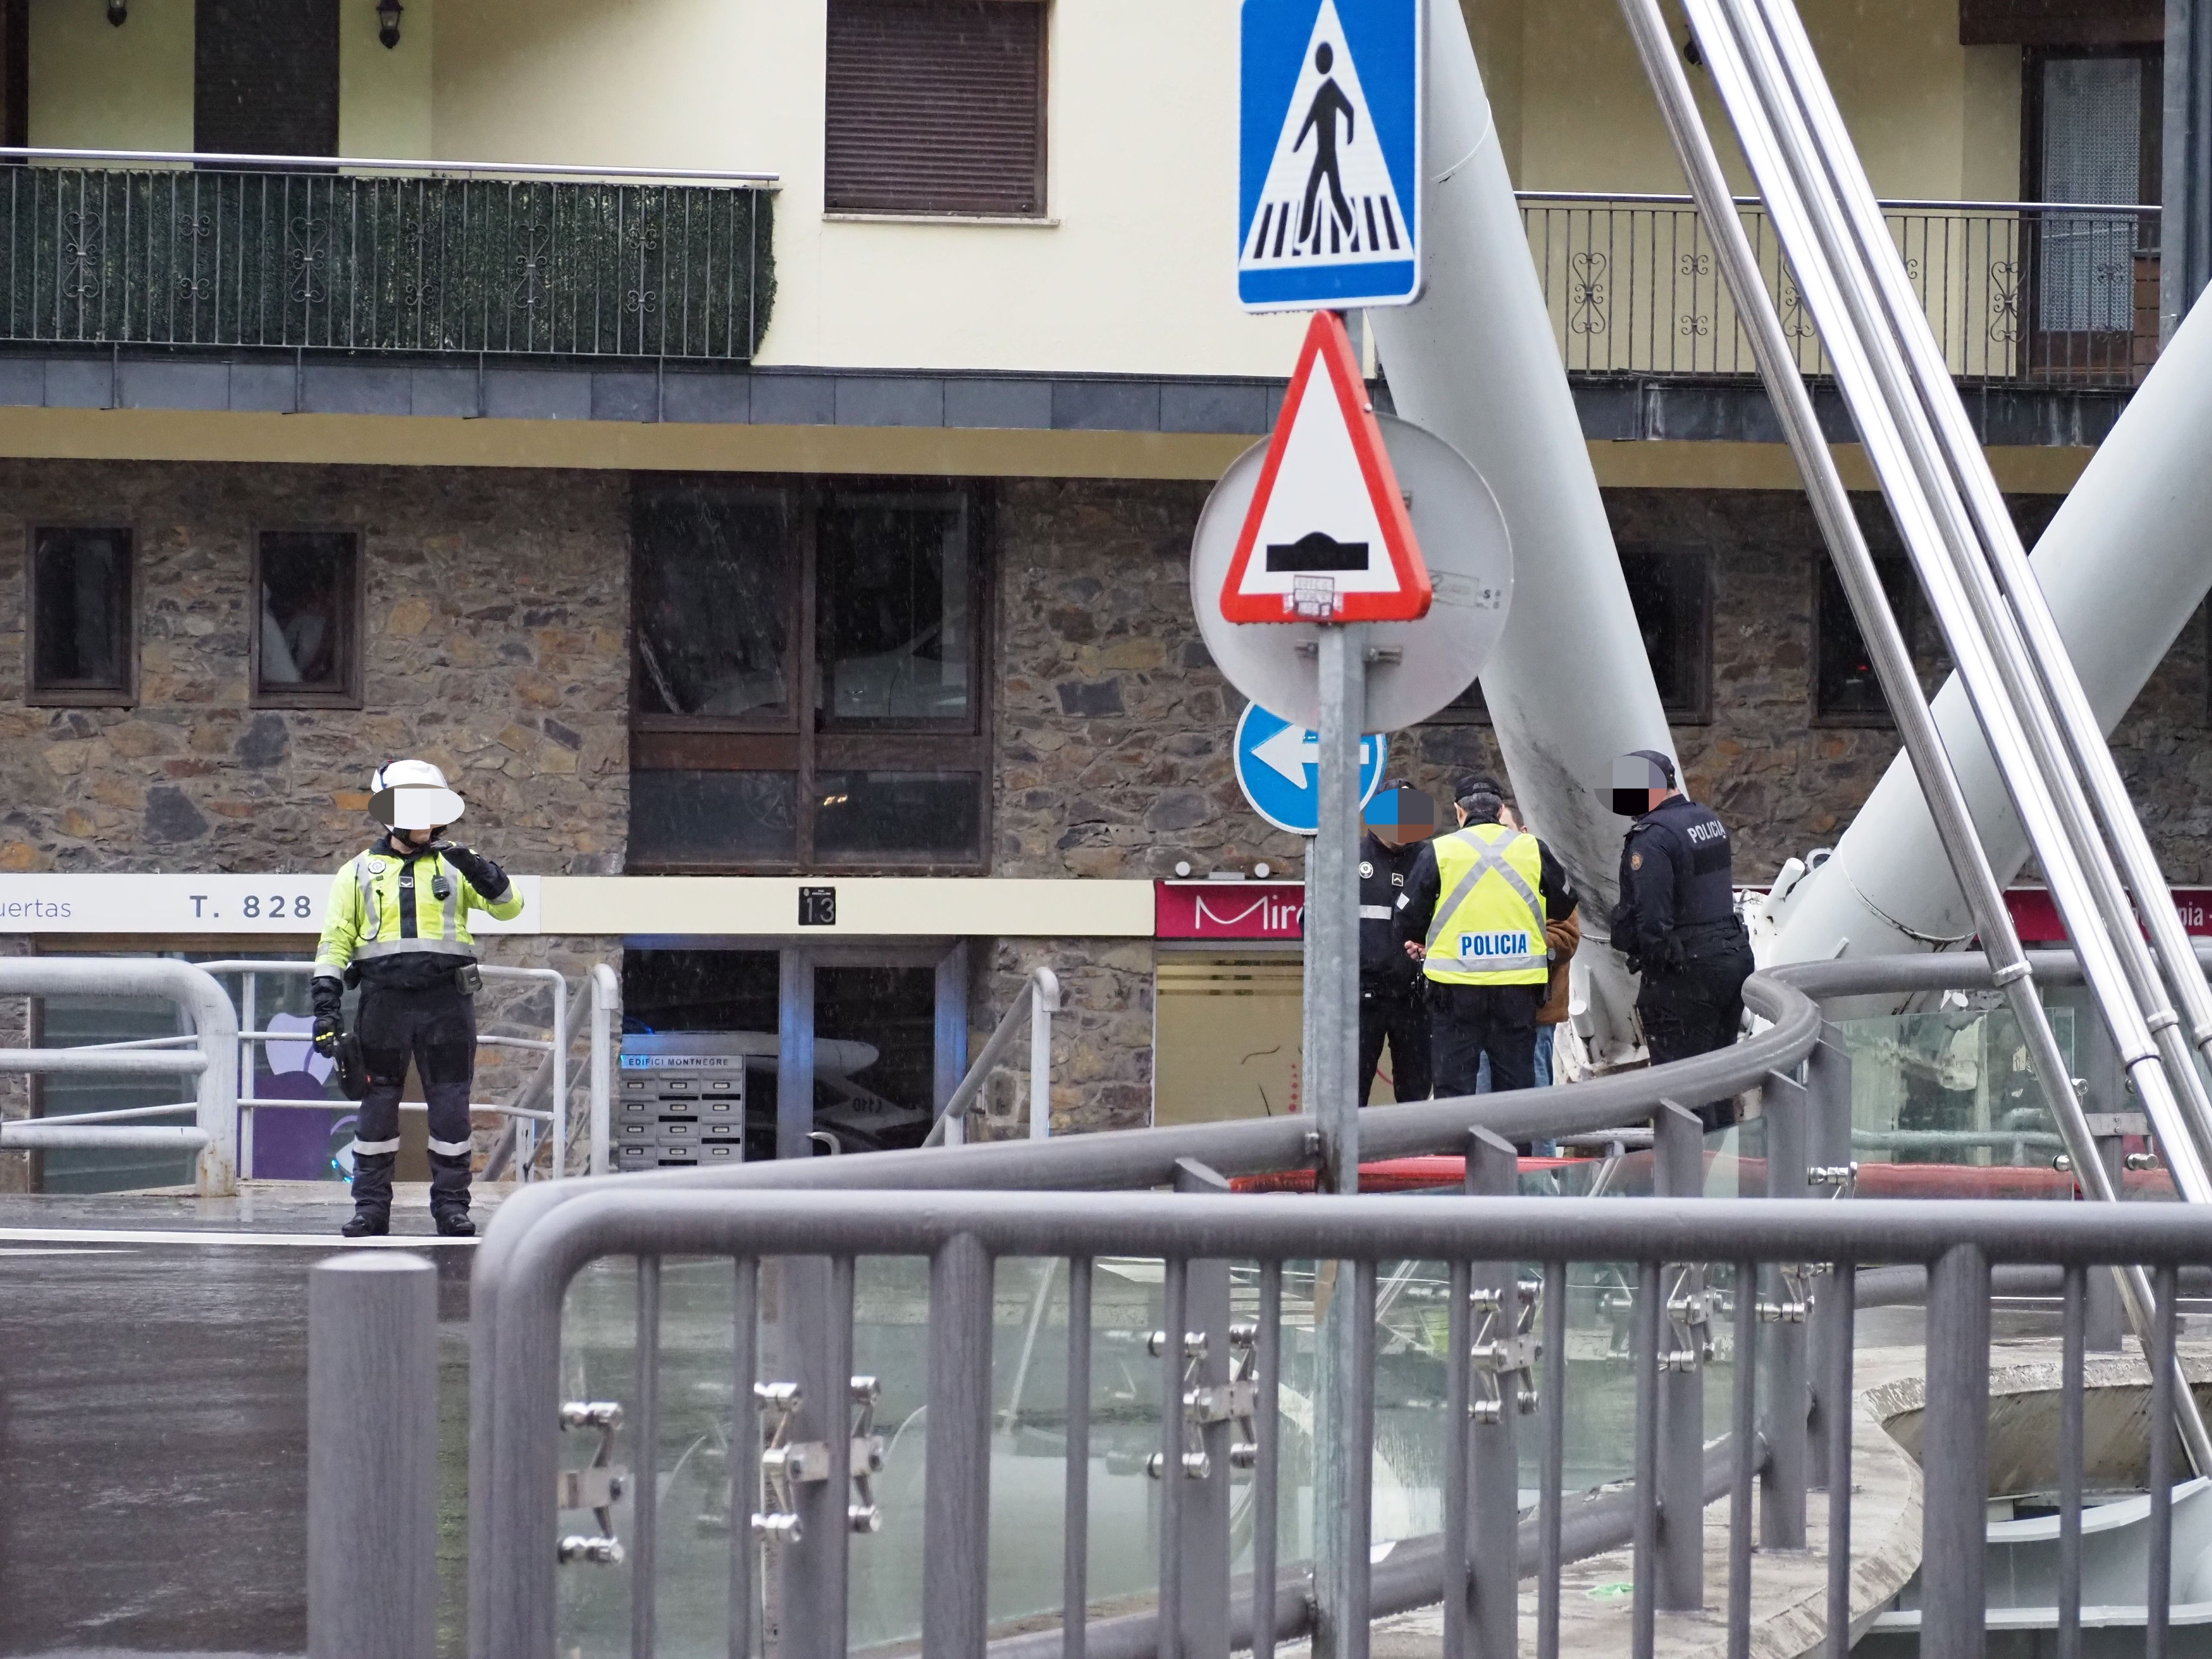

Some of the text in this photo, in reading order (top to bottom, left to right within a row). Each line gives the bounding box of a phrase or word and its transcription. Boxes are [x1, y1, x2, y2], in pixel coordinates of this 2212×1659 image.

[1687, 820, 1726, 843] POLICIA
[189, 895, 311, 918] T. 828
[806, 897, 834, 923] 13
[1195, 895, 1304, 930] Mir
[1462, 934, 1527, 956] POLICIA
